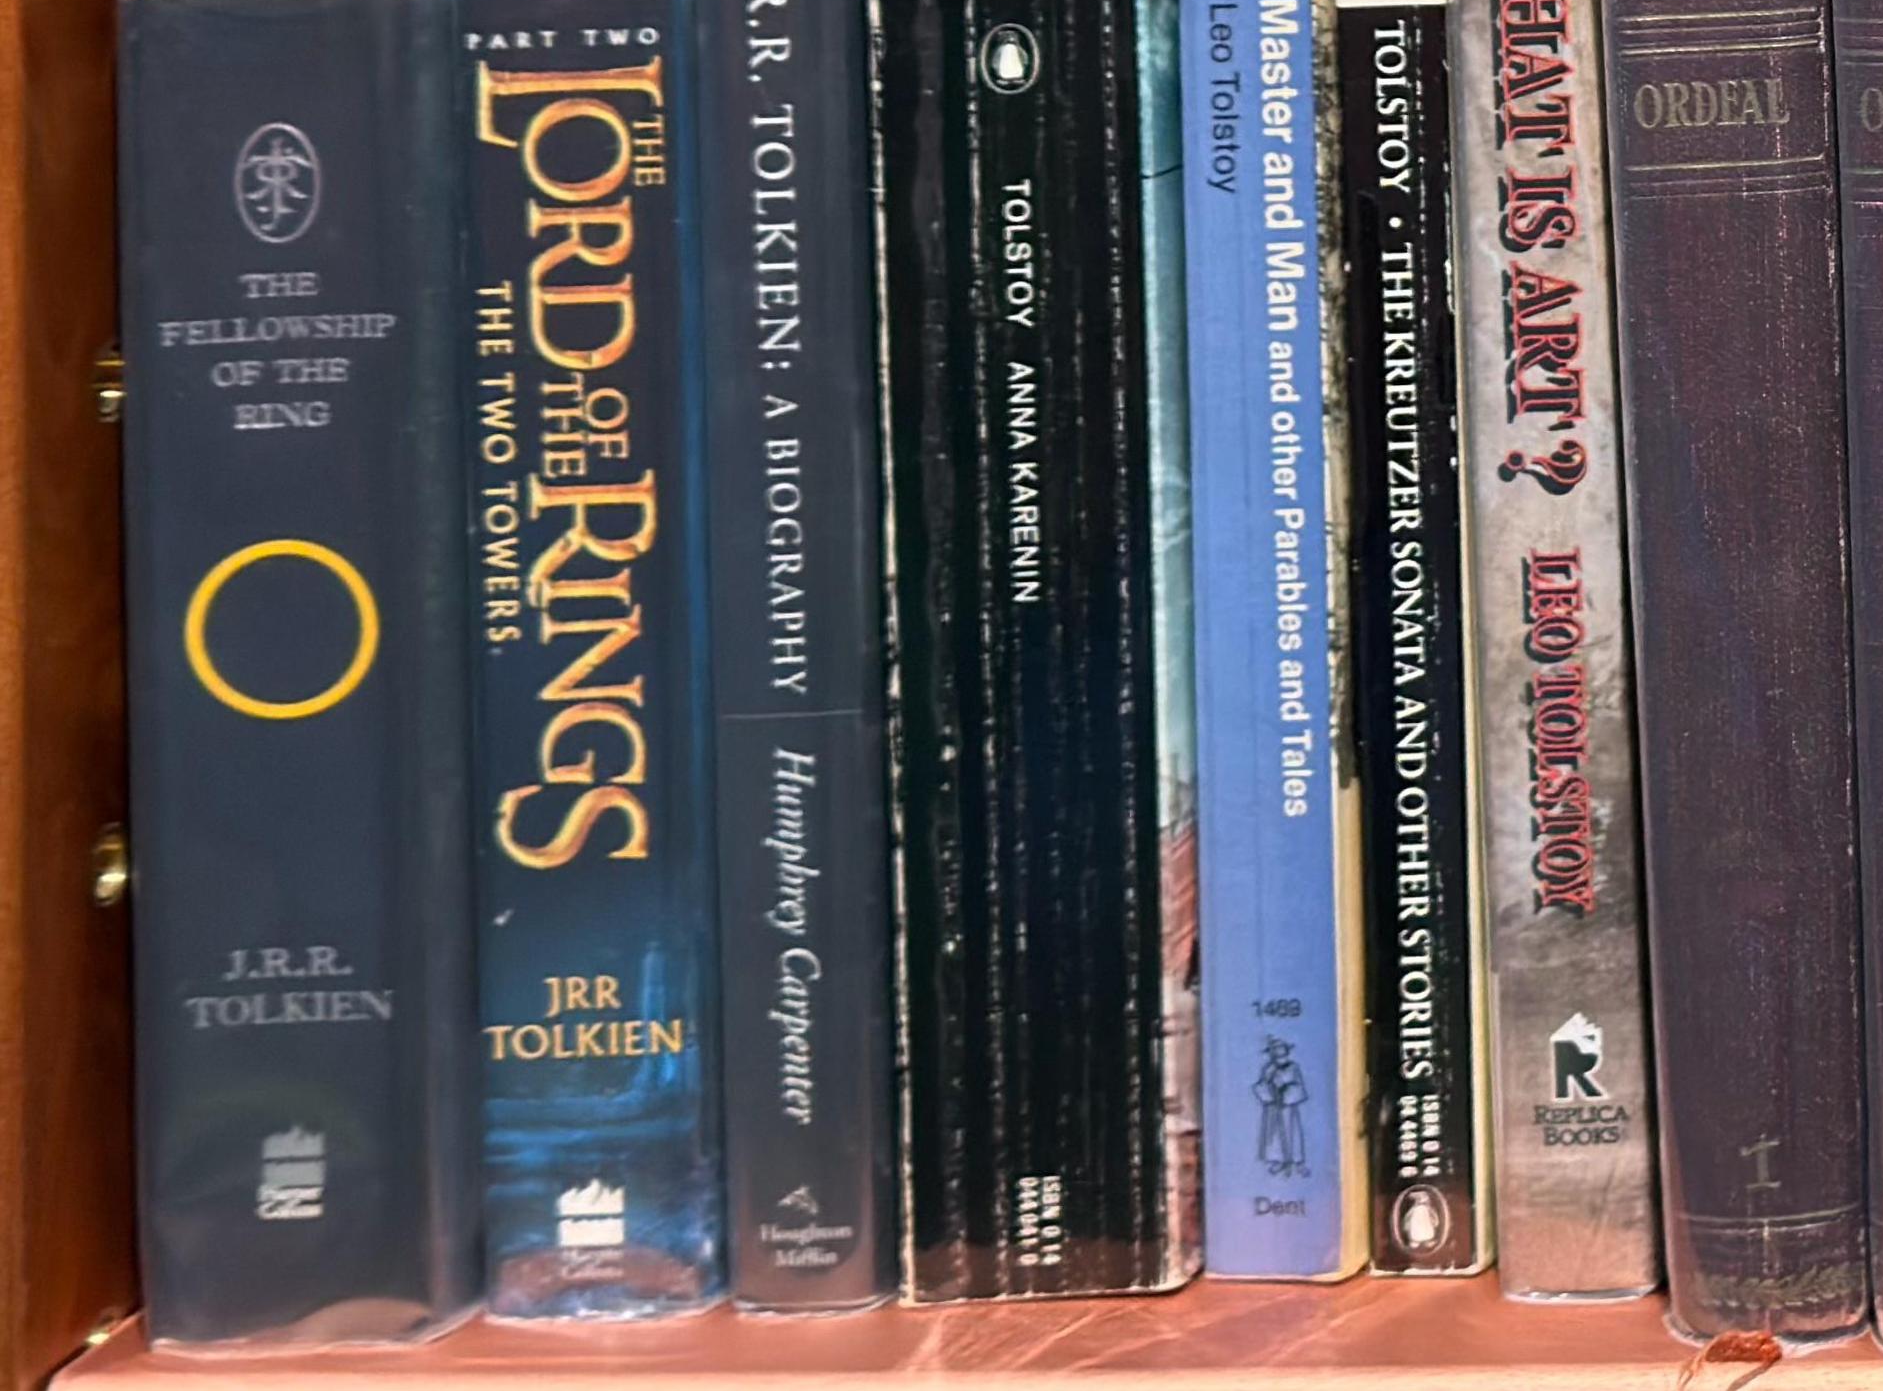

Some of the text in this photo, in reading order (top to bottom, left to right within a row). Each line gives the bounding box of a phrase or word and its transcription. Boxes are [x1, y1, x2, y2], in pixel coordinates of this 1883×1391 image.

[464, 26, 660, 51] PART TWO
[1208, 3, 1241, 194] Leo Tolstoy
[1634, 78, 1789, 131] ORDEAL
[631, 114, 666, 187] THE
[475, 56, 663, 371] LORD
[1263, 152, 1304, 229] and
[1497, 166, 1582, 253] IS
[750, 105, 800, 372] TOLKIEN:
[239, 271, 319, 297] THE
[1266, 241, 1306, 332] Man
[157, 314, 396, 347] FELLOWSHIP
[211, 357, 350, 387] OF THE
[762, 395, 798, 420] A
[1001, 179, 1042, 603] TOLSTOY ANNA KARENIN
[1270, 341, 1302, 402] and
[233, 401, 331, 430] RING
[540, 373, 588, 478] THE
[587, 386, 630, 460] OF
[475, 281, 522, 642] THE TWO TOWERS
[1271, 411, 1304, 500] other
[763, 439, 808, 694] BIOGRAPHY
[1273, 508, 1306, 652] Parables
[1374, 19, 1434, 1081] TOLSTOY THE KREUTZER SONATA AND OTHER STORIES
[495, 468, 657, 869] RINGS
[1279, 662, 1311, 722] and
[1521, 547, 1596, 919] LEO TOLSTOY
[1281, 729, 1314, 817] Tales
[222, 945, 353, 980] J.R.R.
[762, 747, 822, 1126] Humphrey Carpenter
[184, 989, 394, 1029] TOLKIEN
[544, 975, 621, 1019] JRR
[482, 1019, 685, 1060] TOLKIEN
[1534, 1104, 1630, 1125] REPLICA
[1544, 1125, 1621, 1146] BOOKS
[1739, 1133, 1780, 1188] 1
